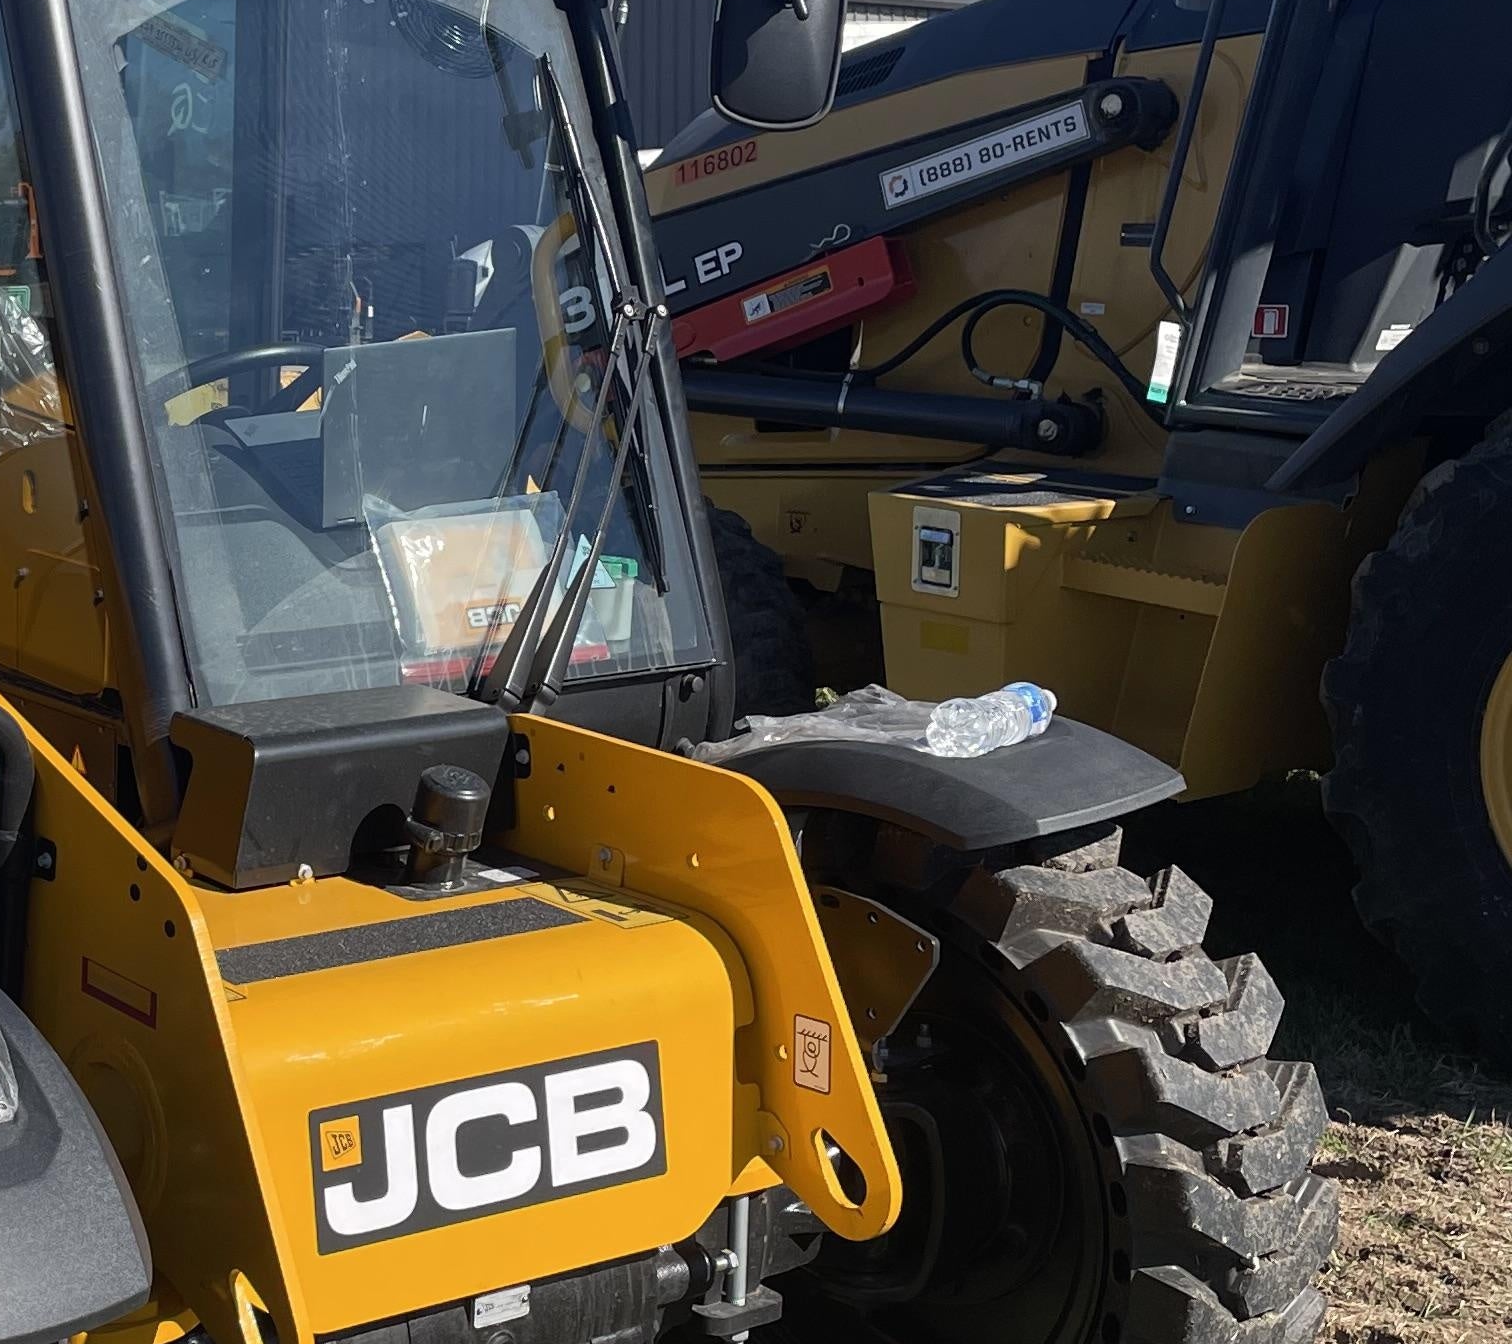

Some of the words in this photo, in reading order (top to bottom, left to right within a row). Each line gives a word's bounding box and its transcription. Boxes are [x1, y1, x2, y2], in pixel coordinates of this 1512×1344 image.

[677, 141, 758, 184] 116802
[918, 152, 973, 187] (888)
[978, 115, 1077, 164] 80-RENTS
[694, 241, 743, 284] EP
[324, 1059, 657, 1235] JCB
[330, 1133, 354, 1155] JCB
